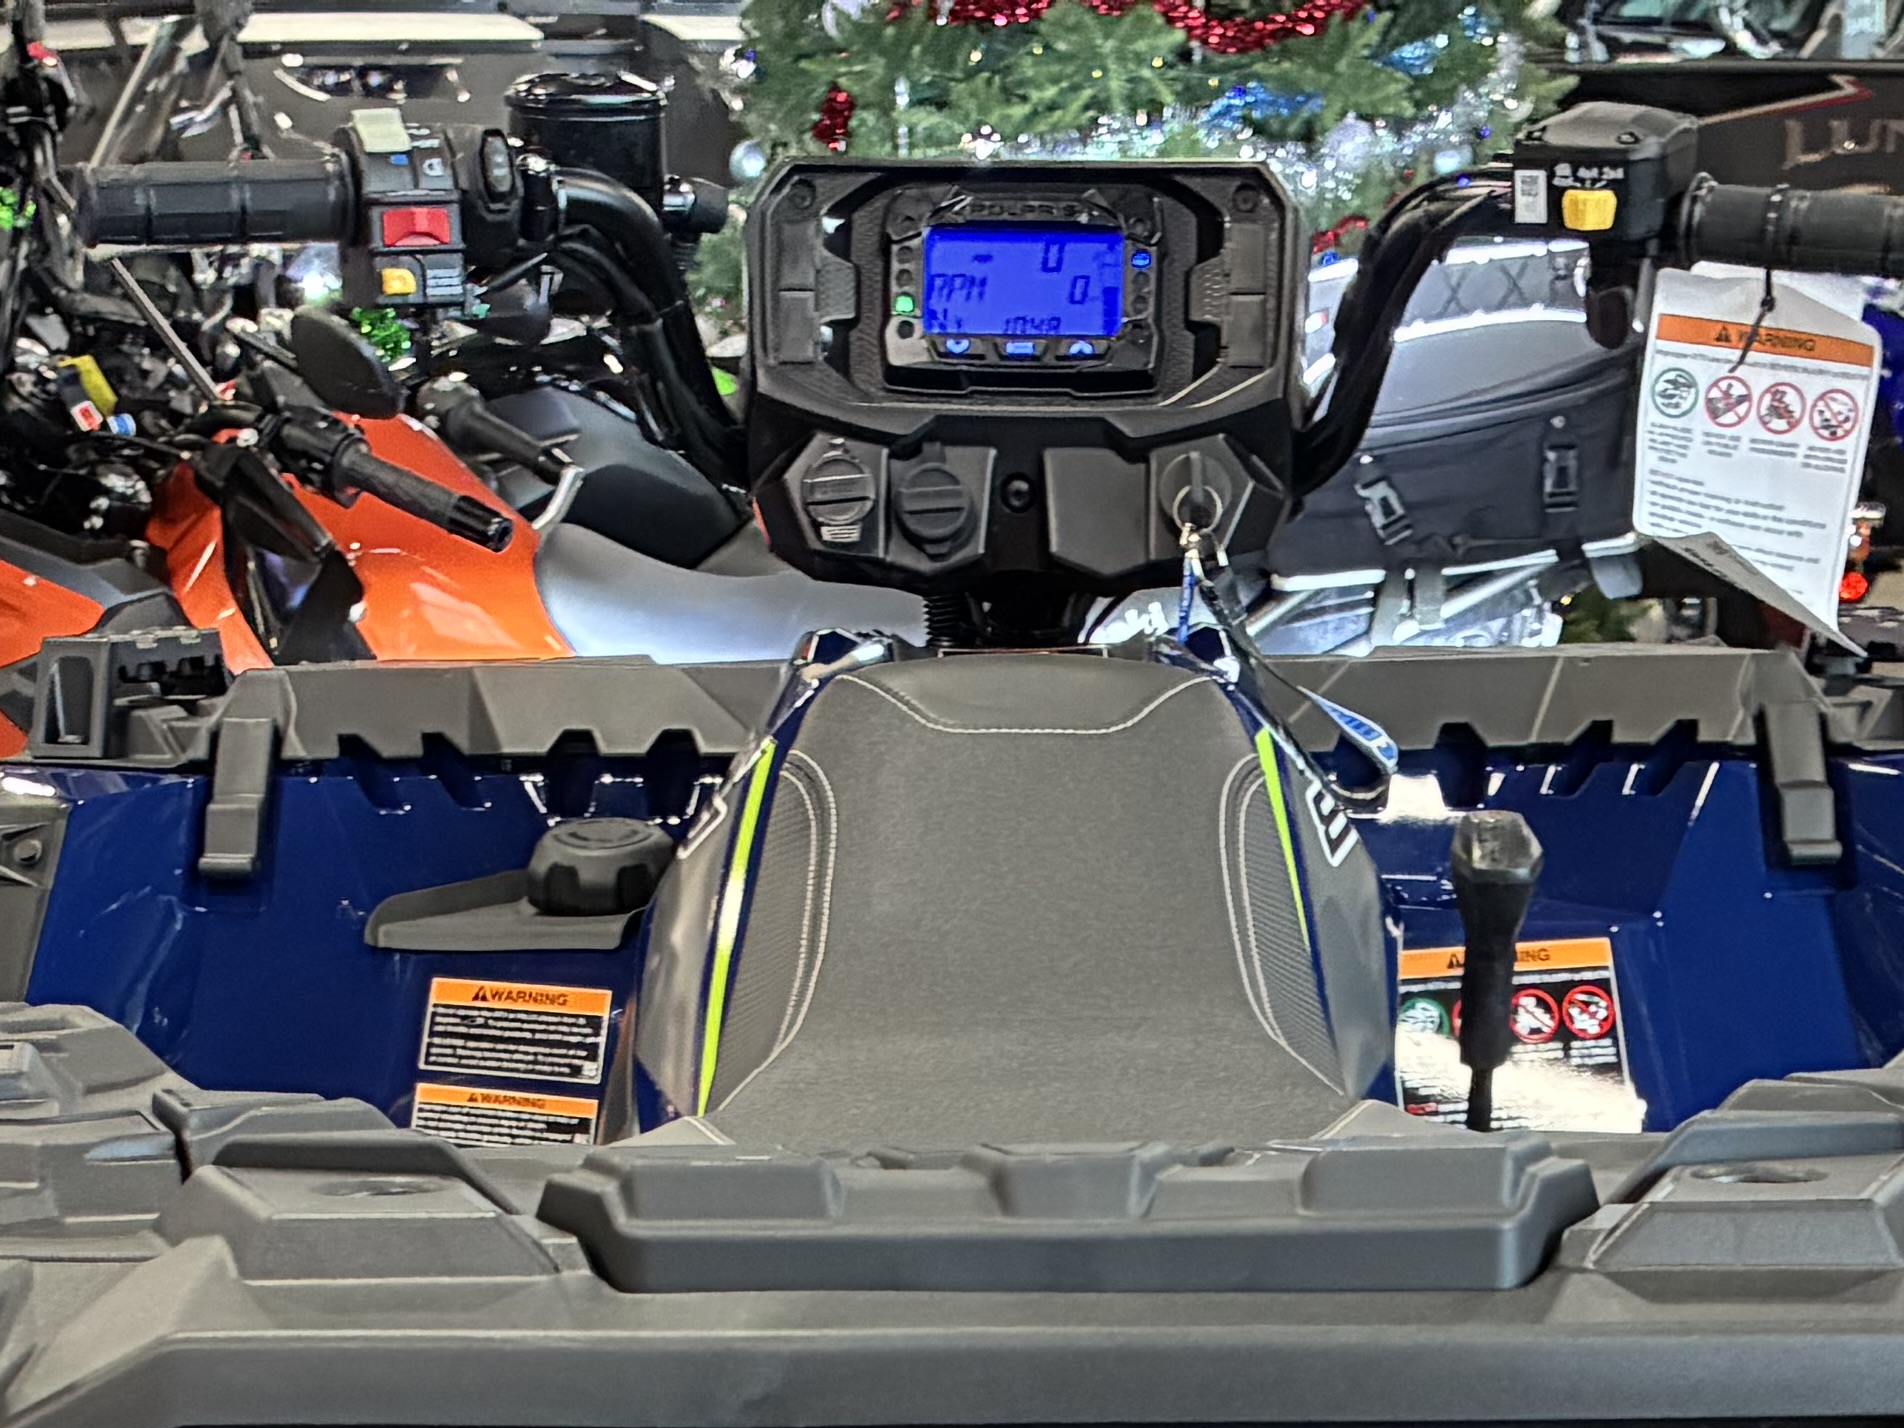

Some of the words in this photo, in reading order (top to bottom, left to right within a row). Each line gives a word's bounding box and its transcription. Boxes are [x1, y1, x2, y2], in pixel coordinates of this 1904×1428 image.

[1069, 274, 1091, 305] 0
[490, 987, 569, 1007] WARNING
[480, 1092, 545, 1110] WARNING
